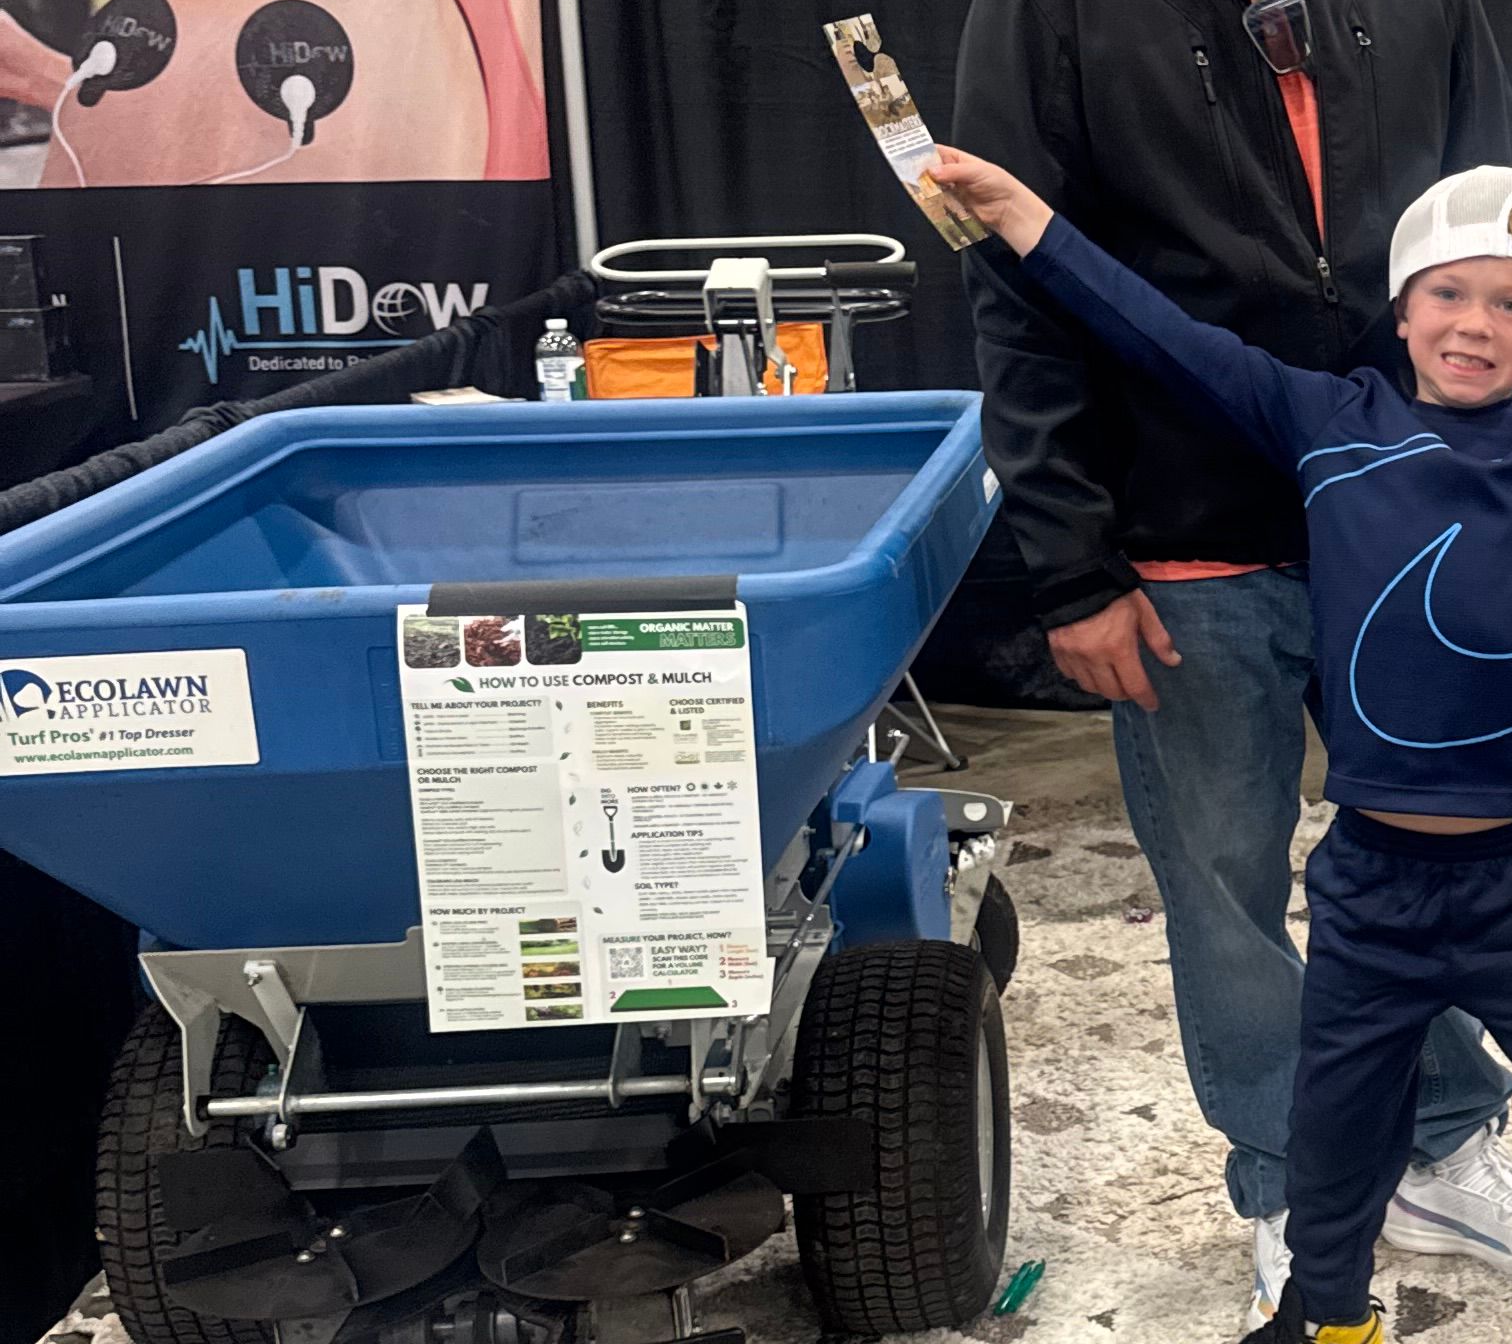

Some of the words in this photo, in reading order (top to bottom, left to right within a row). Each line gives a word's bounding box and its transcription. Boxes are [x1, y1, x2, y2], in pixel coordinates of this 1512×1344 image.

[249, 356, 325, 370] Dedicated
[328, 356, 343, 370] to
[639, 622, 691, 634] ORGANIC
[692, 622, 735, 632] MATTER
[659, 632, 737, 648] MATTERS
[479, 676, 516, 689] HOW
[519, 676, 539, 688] TO
[543, 675, 569, 687] USE
[572, 673, 644, 686] COMPOST
[647, 673, 658, 684] &
[661, 671, 713, 684] MULCH
[55, 674, 209, 704] ECOLAWN
[411, 702, 428, 710] TELL
[444, 701, 473, 709] ABOUT
[475, 700, 498, 708] YOUR
[500, 699, 542, 708] PROJECT?
[586, 700, 624, 709] BENEFITS
[669, 698, 704, 707] CHOOSE
[705, 697, 745, 706] CERTIFIED
[60, 698, 213, 720] APPLICATOR
[678, 707, 705, 715] LISTED
[7, 730, 46, 746] Turf
[99, 730, 115, 741] #1
[118, 729, 142, 742] Top
[145, 727, 195, 740] Dresser
[14, 745, 194, 764] www.ecolawnapplicator.com
[417, 767, 452, 775] CHOOSE
[453, 767, 468, 775] THE
[470, 766, 494, 774] RIGHT
[496, 765, 538, 774] COMPOST
[417, 776, 430, 784] OR
[431, 776, 461, 784] MULCH
[627, 785, 649, 793] HOW
[650, 784, 681, 793] OFTEN?
[630, 830, 685, 839] APPLICATION
[686, 829, 704, 838] TIPS
[634, 882, 653, 890] SOIL
[654, 881, 679, 889] TYPE?
[429, 908, 451, 916] HOW
[452, 907, 476, 915] MUCH
[478, 907, 488, 915] BY
[490, 906, 526, 915] PROJECT
[602, 936, 641, 944] MEASURE
[642, 934, 666, 942] YOUR
[706, 931, 732, 939] HOW?
[651, 945, 677, 955] EASY
[678, 944, 708, 953] WAY?
[652, 969, 698, 977] CALCULATOR
